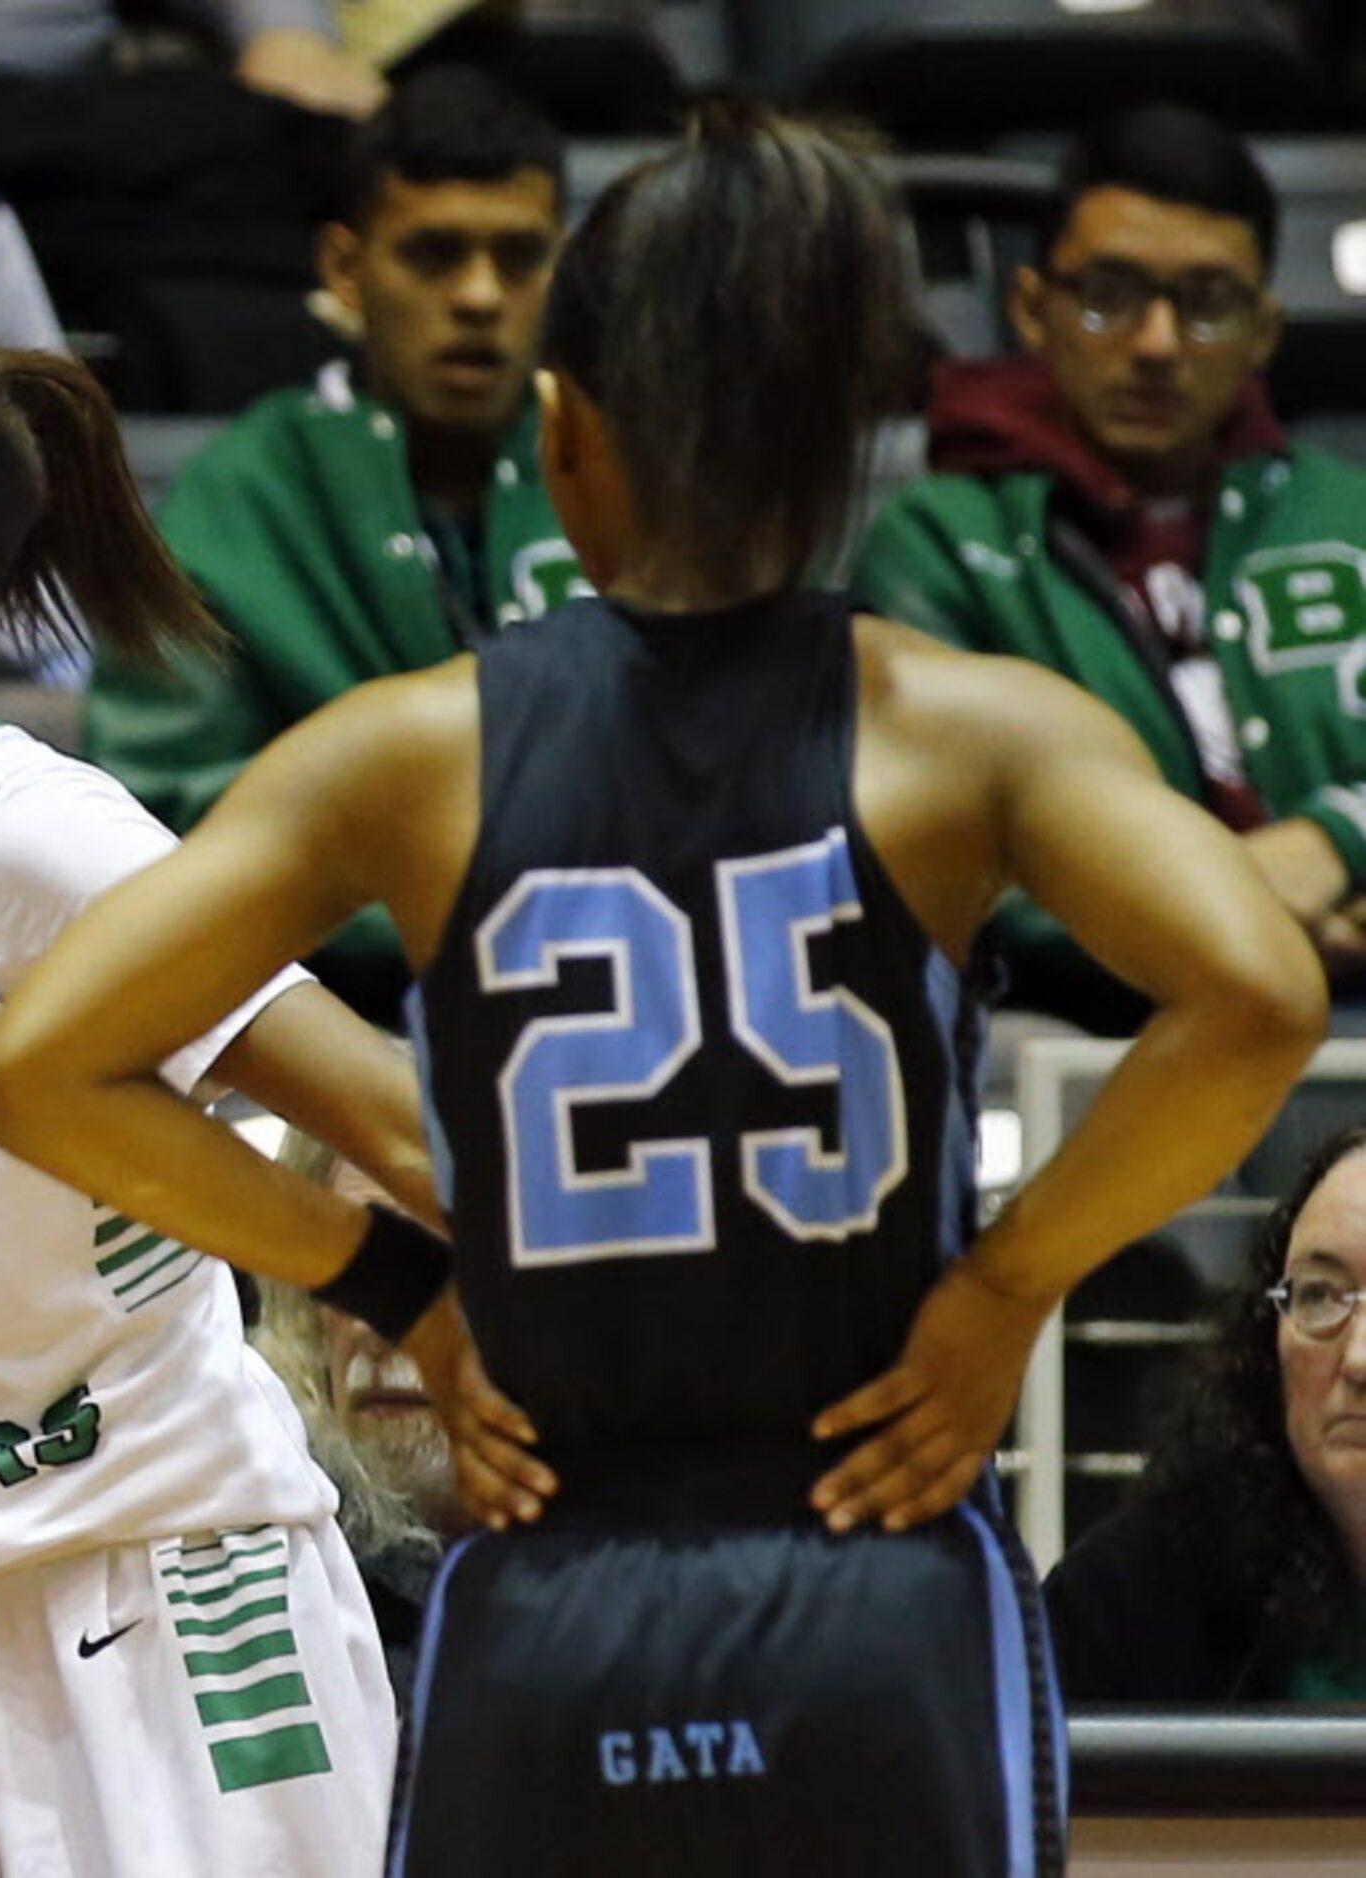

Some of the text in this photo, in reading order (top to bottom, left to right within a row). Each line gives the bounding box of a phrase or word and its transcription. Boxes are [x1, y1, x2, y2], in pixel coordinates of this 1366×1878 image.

[1234, 540, 1366, 676] B
[476, 826, 909, 1269] 25
[599, 1721, 765, 1785] GATA
